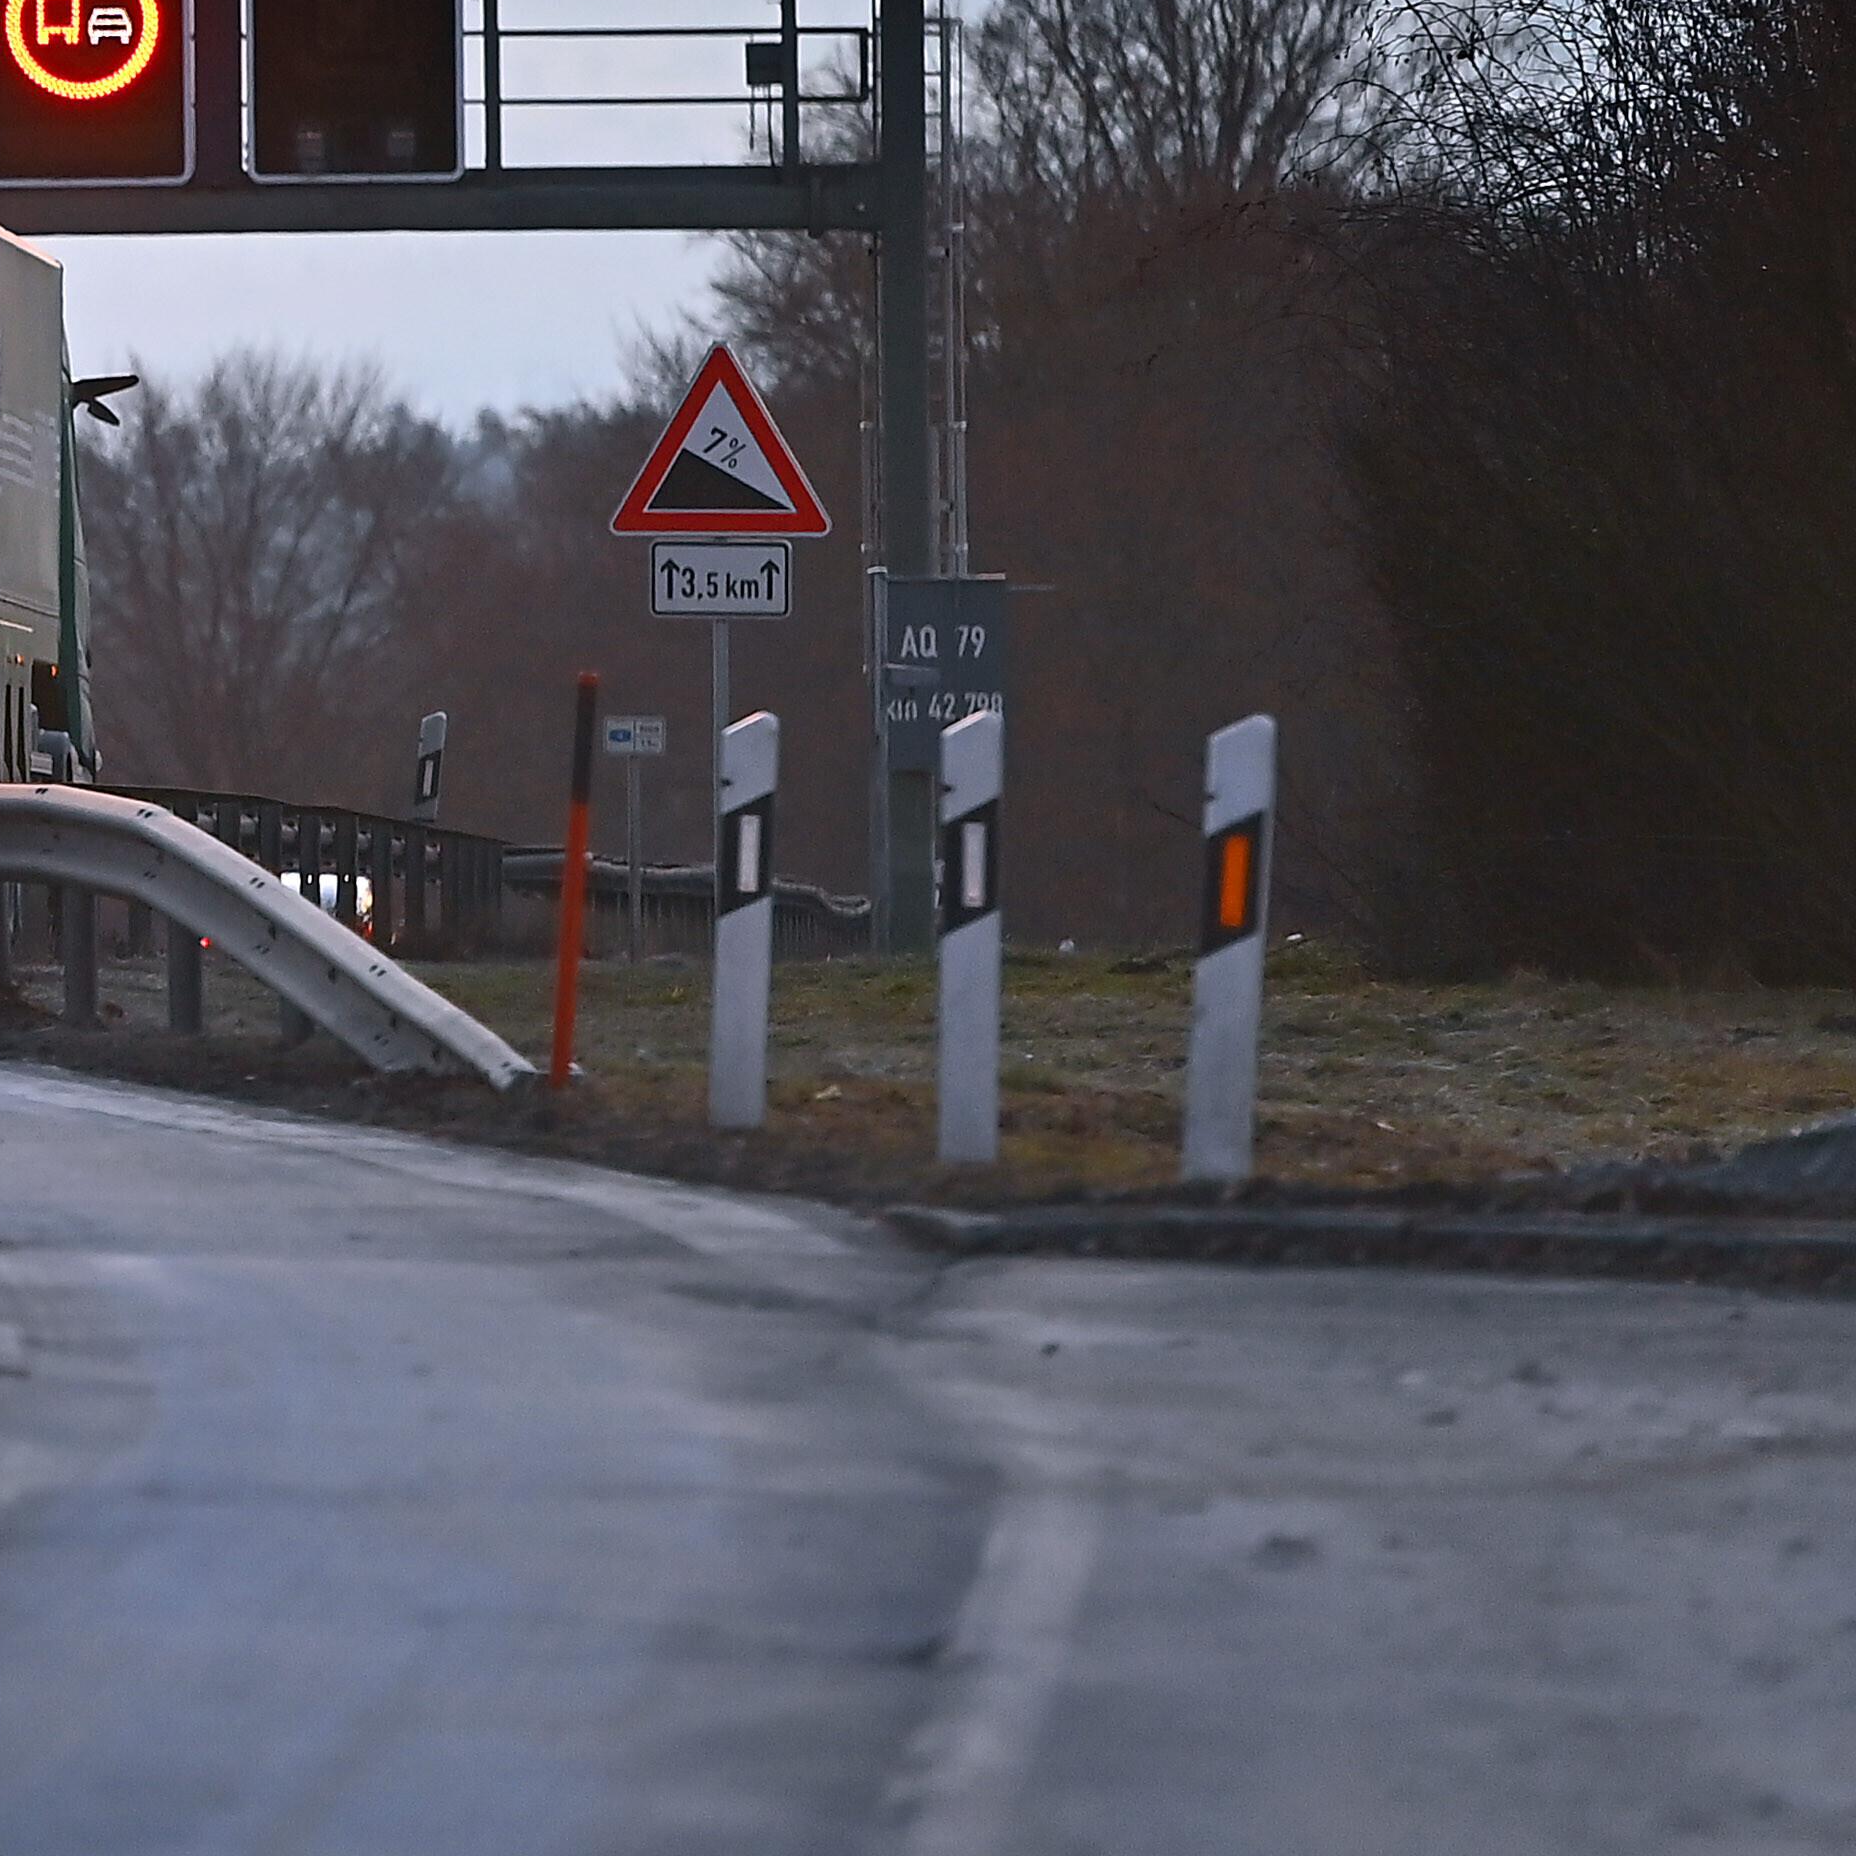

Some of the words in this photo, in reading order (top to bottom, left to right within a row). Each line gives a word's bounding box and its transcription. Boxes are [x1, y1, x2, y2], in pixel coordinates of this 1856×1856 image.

[702, 425, 747, 470] 7%
[680, 565, 719, 601] 3,5
[725, 571, 760, 600] km
[899, 624, 939, 659] AQ
[956, 625, 987, 659] 79
